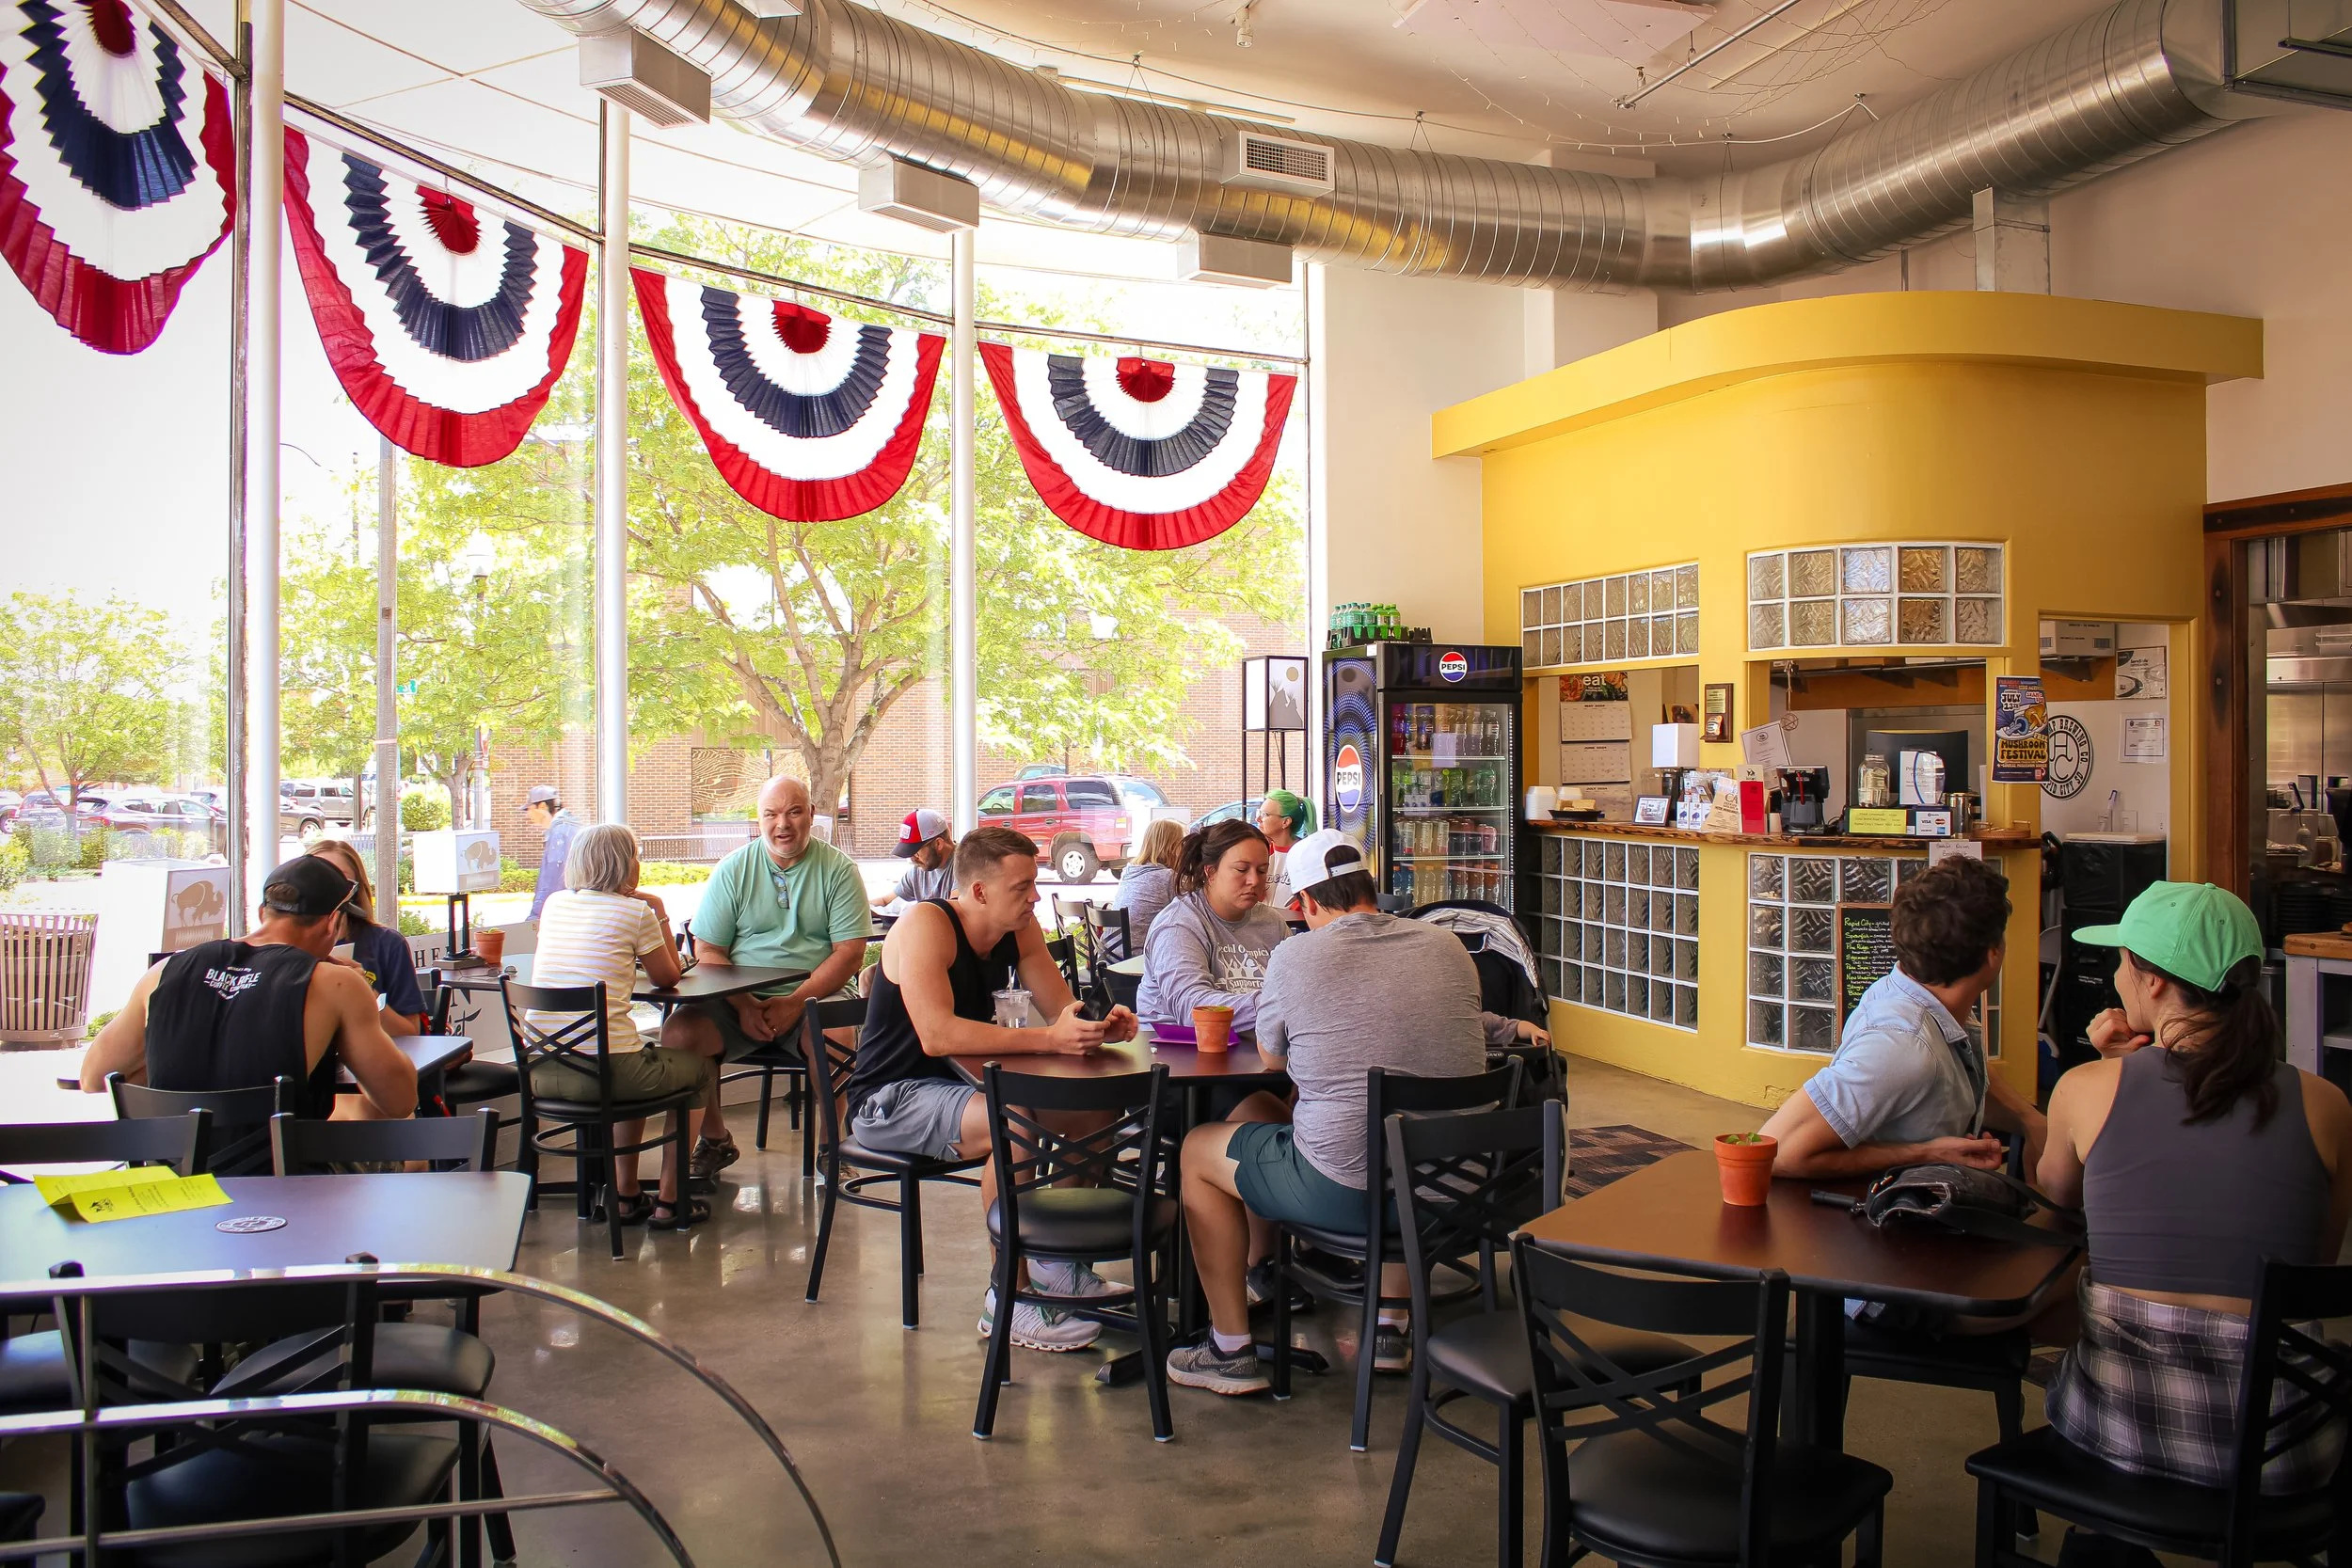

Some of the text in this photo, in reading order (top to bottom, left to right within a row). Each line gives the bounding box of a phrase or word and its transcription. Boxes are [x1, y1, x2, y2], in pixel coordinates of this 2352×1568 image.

[1582, 674, 1607, 686] eat
[2001, 693, 2021, 703] JULY
[2034, 734, 2048, 742] FREE
[2059, 719, 2087, 748] BREWING
[2079, 752, 2089, 764] CO.
[2001, 740, 2045, 749] MUSHROOM
[2000, 750, 2046, 760] FESTIVAL
[1337, 771, 1360, 785] PEPSI
[2059, 780, 2074, 796] CITY
[2074, 770, 2085, 784] SD
[1845, 917, 1860, 927] Rapid
[1860, 918, 1871, 927] City
[205, 968, 239, 986] BLACK
